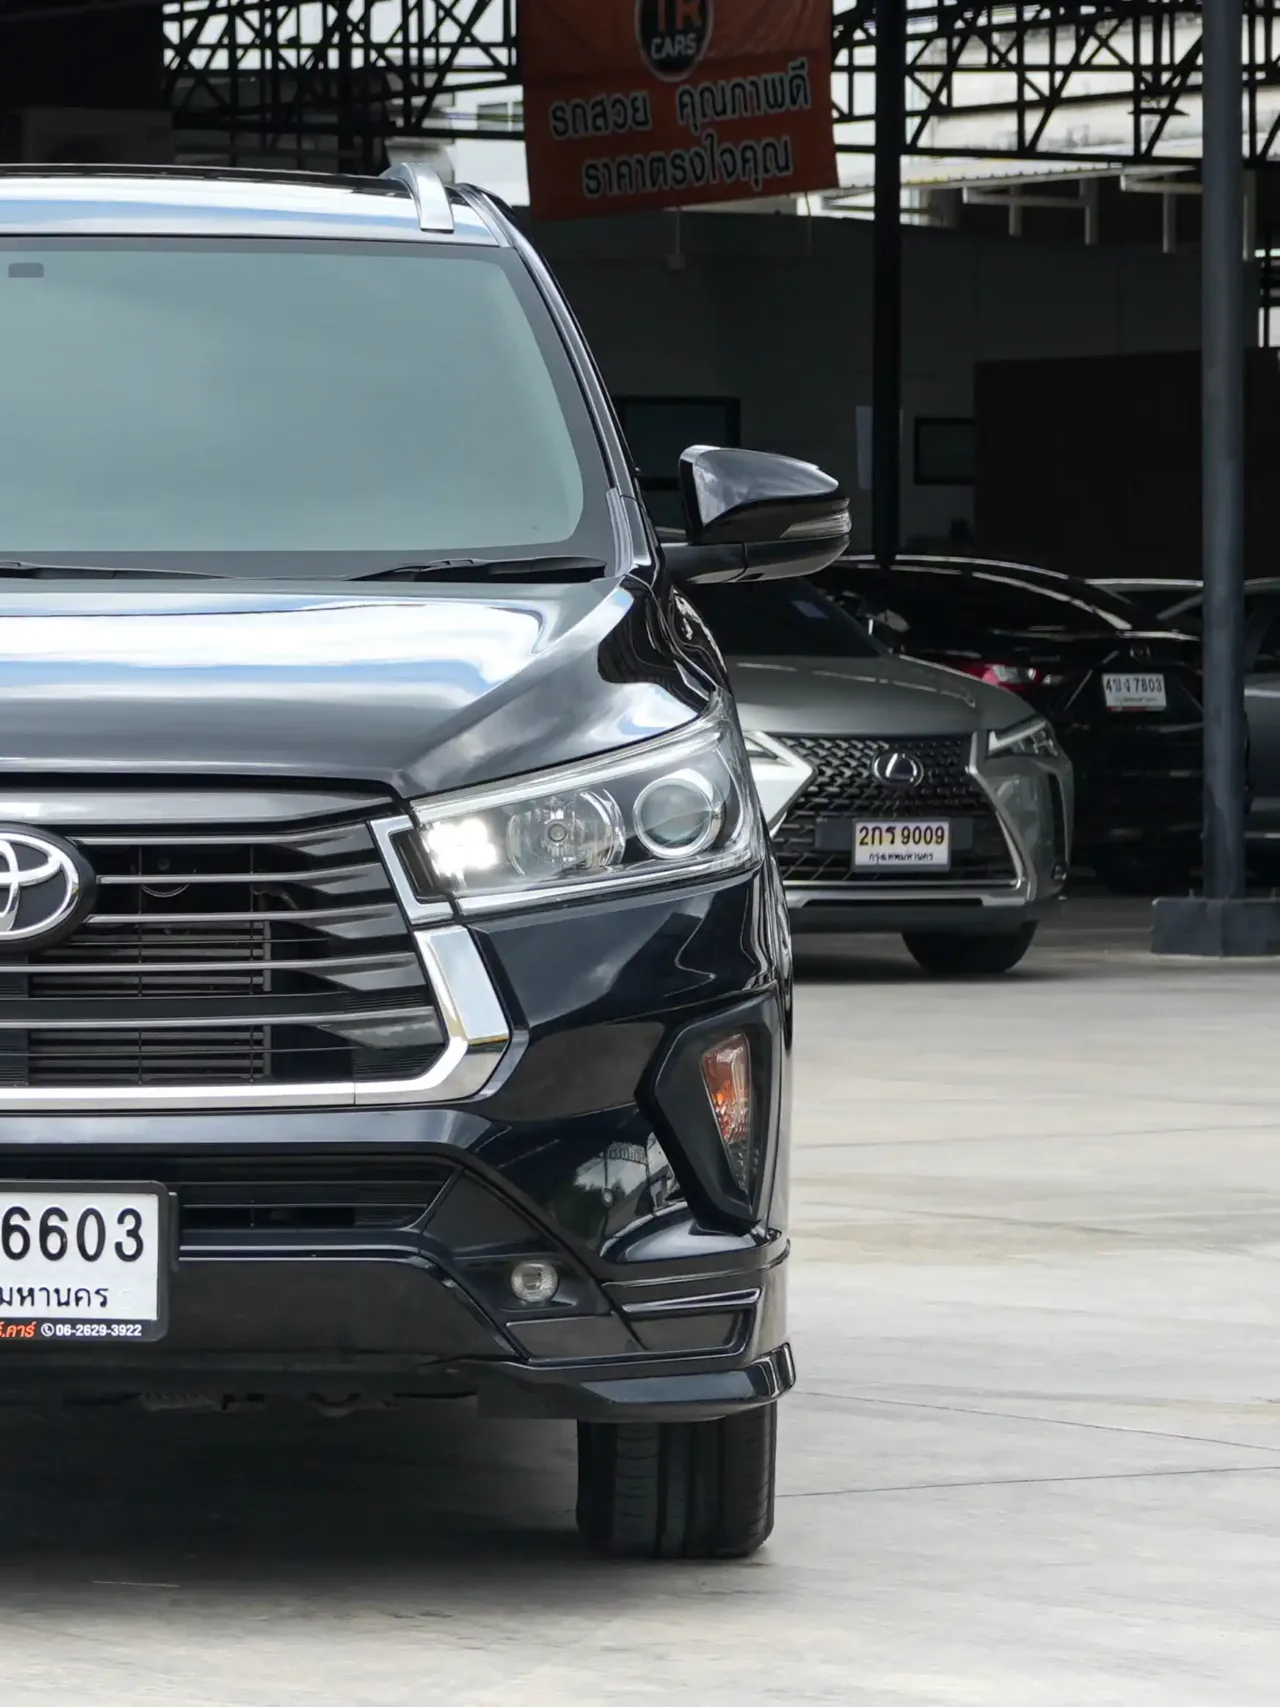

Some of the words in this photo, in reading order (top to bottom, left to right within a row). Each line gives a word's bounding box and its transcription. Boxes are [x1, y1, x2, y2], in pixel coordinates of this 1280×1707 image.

[650, 32, 698, 60] CARS
[549, 91, 651, 140] รถสวย
[676, 56, 812, 135] คุณภาพดี
[582, 132, 794, 196] ราคาตรงใจคุณ
[901, 825, 945, 846] 9009
[1, 1206, 144, 1262] 6603
[55, 1323, 142, 1337] 06-2629-3922
